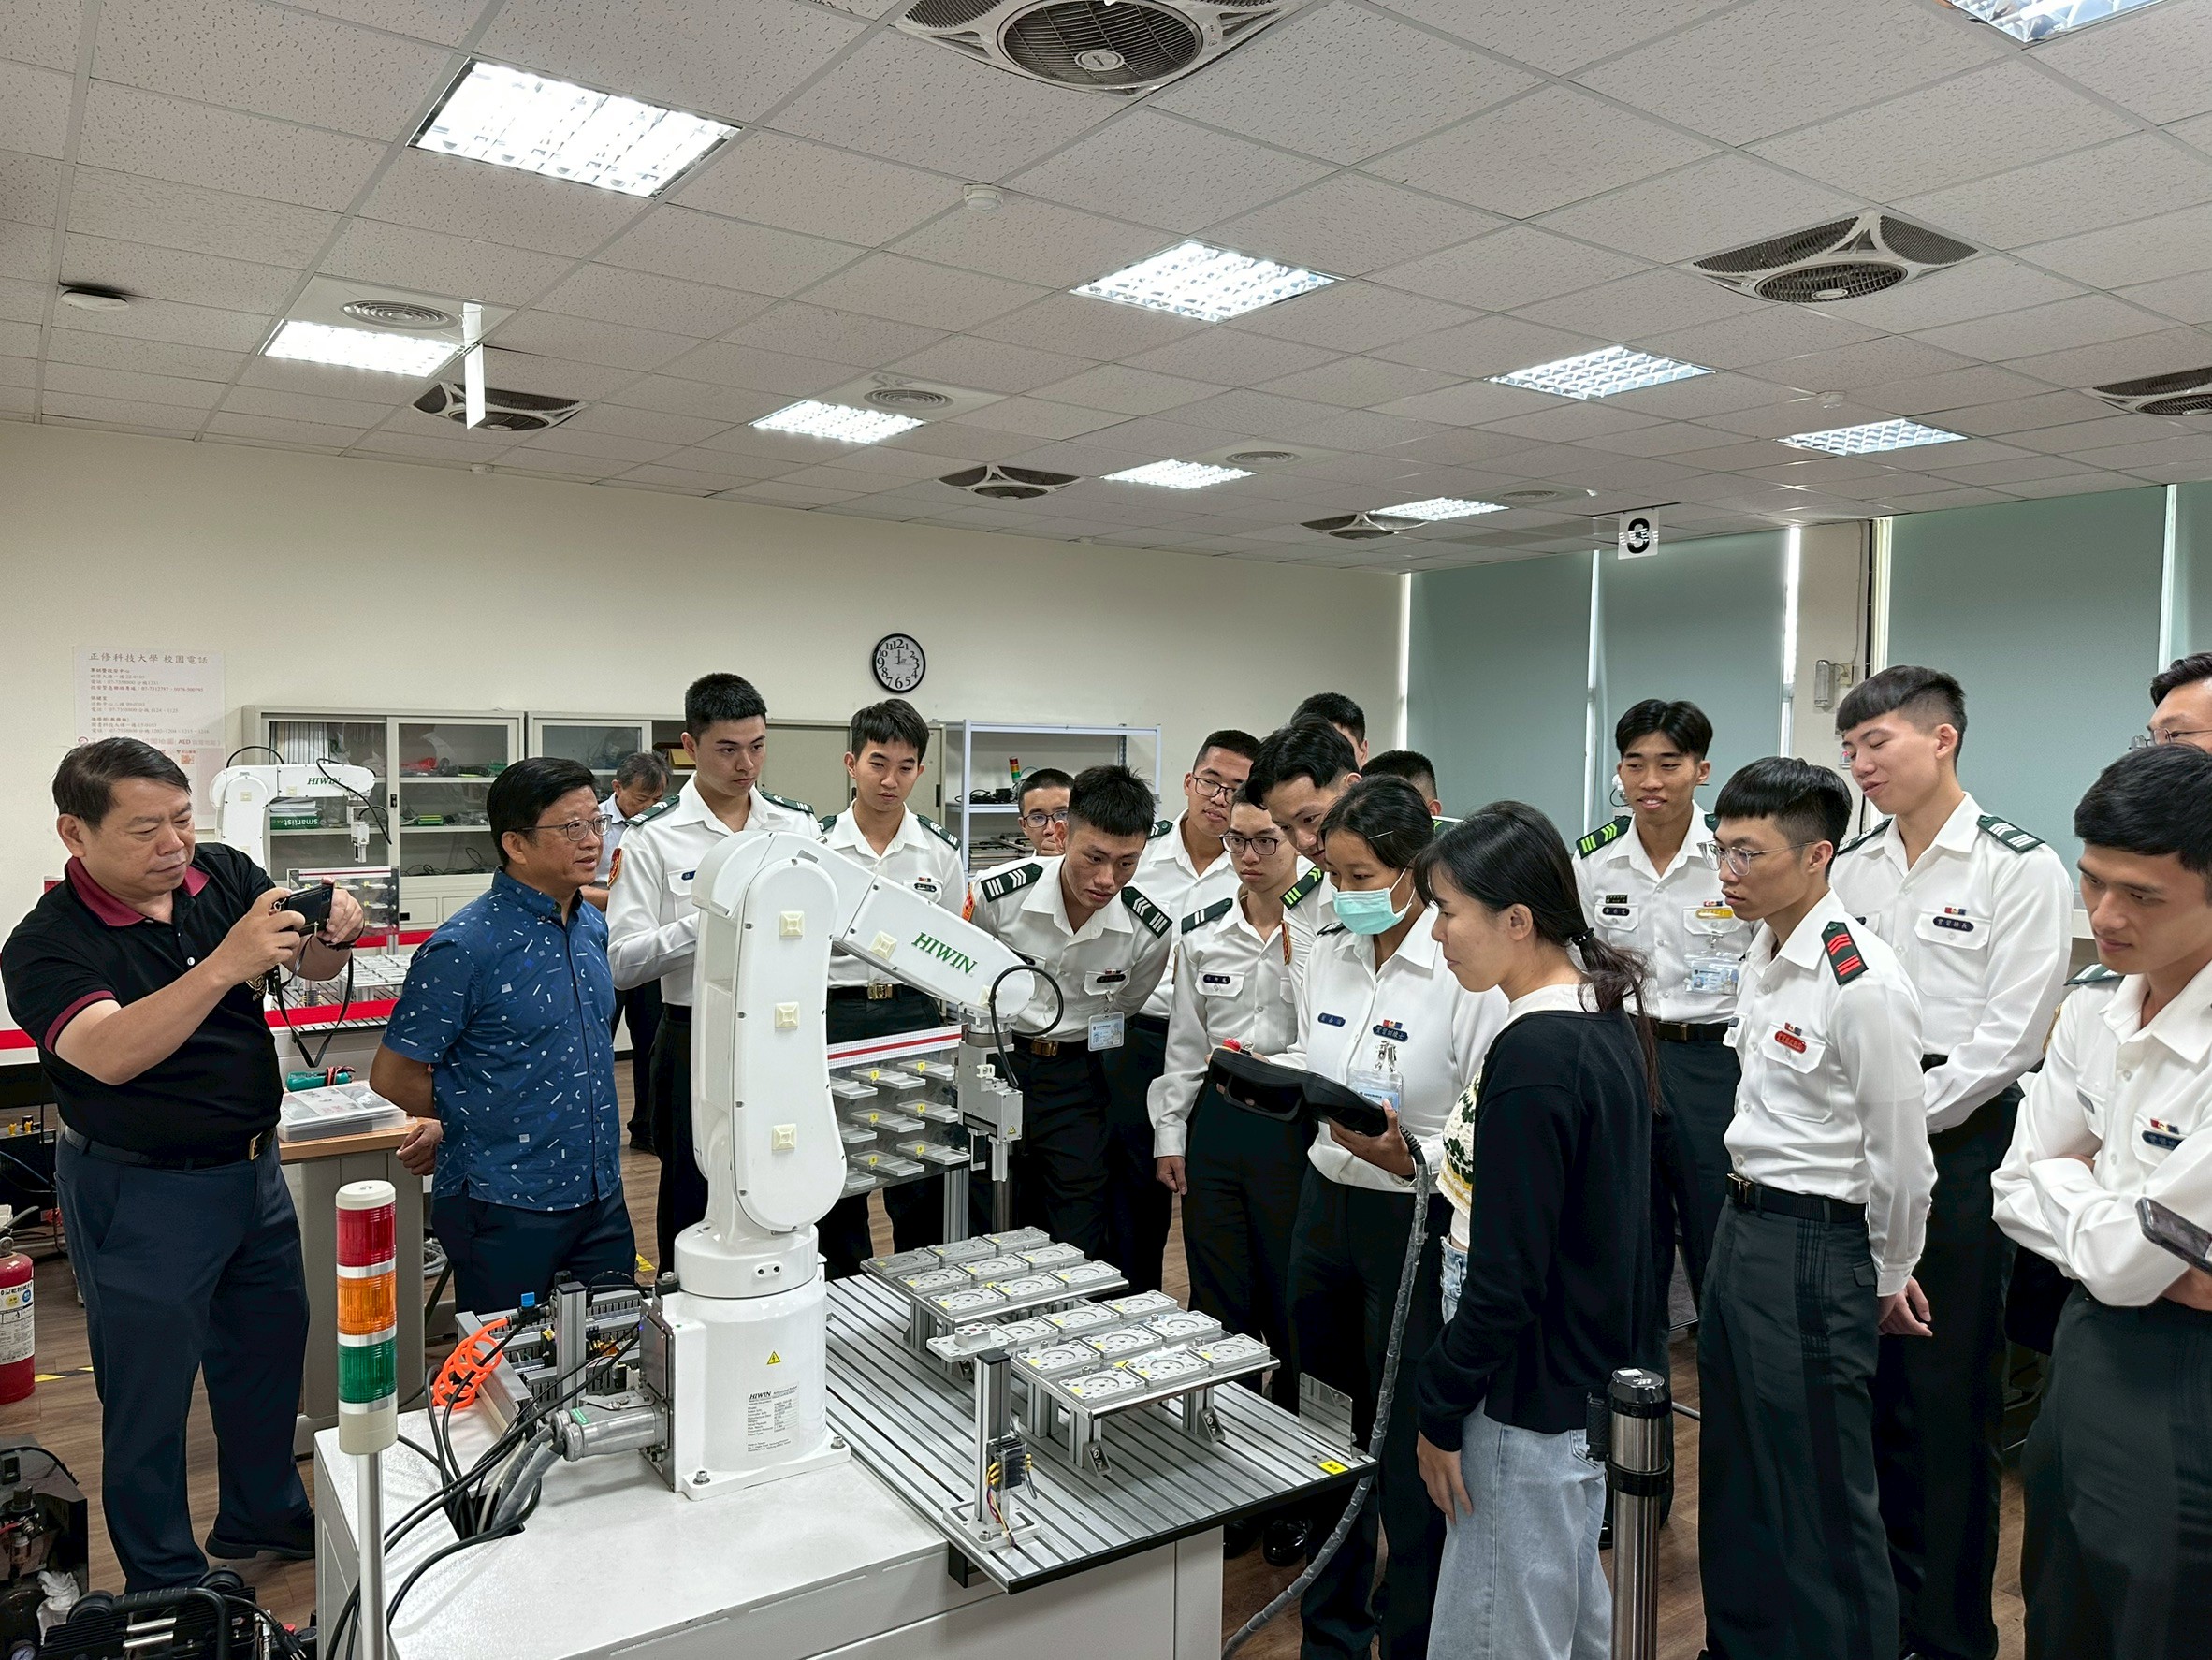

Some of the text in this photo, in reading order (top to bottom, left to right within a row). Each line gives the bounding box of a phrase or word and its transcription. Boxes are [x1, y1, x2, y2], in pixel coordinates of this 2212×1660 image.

[885, 642, 894, 650] 11
[892, 639, 904, 649] 12
[877, 657, 885, 669] 9
[913, 657, 920, 670] 3
[881, 667, 888, 677] 8
[911, 669, 918, 679] 4
[886, 677, 893, 687] 7
[895, 676, 903, 689] 6
[905, 676, 911, 686] 5
[911, 931, 978, 974] HIWIN
[749, 1391, 772, 1400] HIWIN
